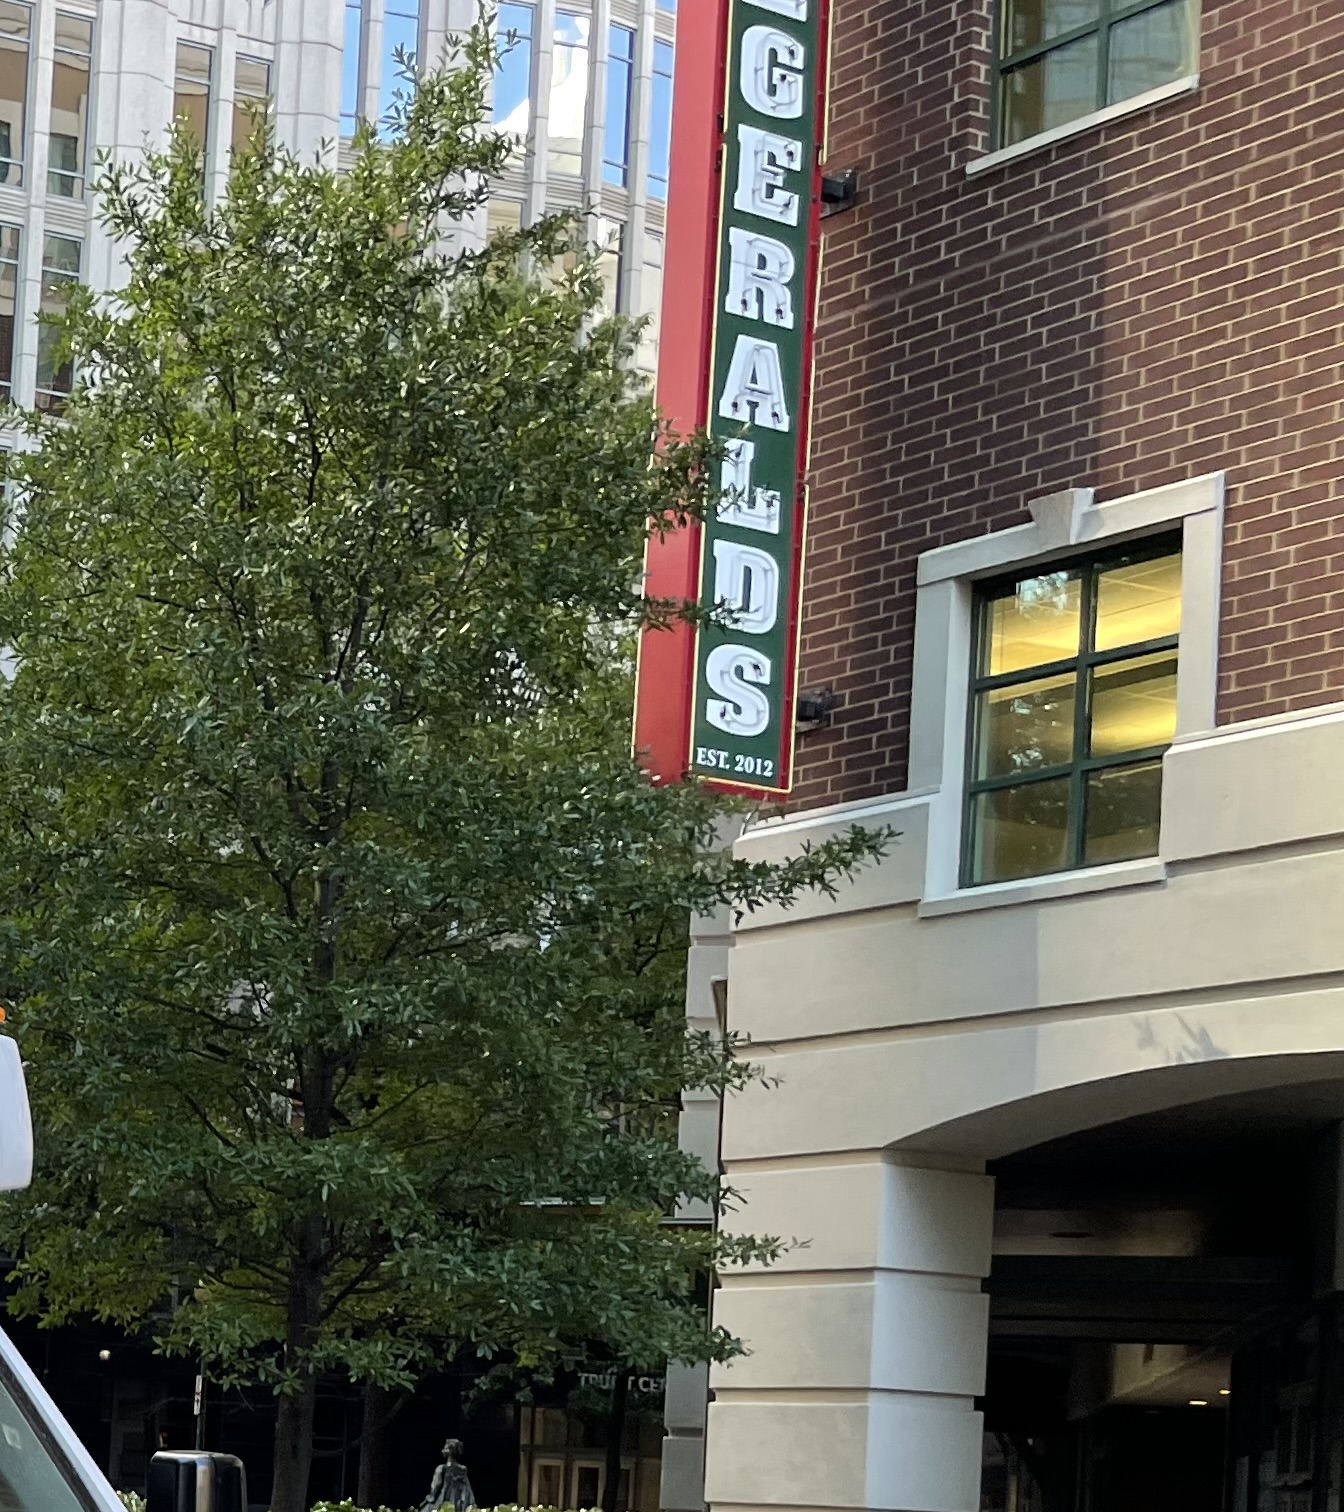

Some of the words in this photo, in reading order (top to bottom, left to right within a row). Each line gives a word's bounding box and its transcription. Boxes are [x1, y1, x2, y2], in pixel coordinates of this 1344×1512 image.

[706, 0, 808, 738] GERALDS
[696, 747, 730, 769] EST.
[734, 754, 774, 777] 2012
